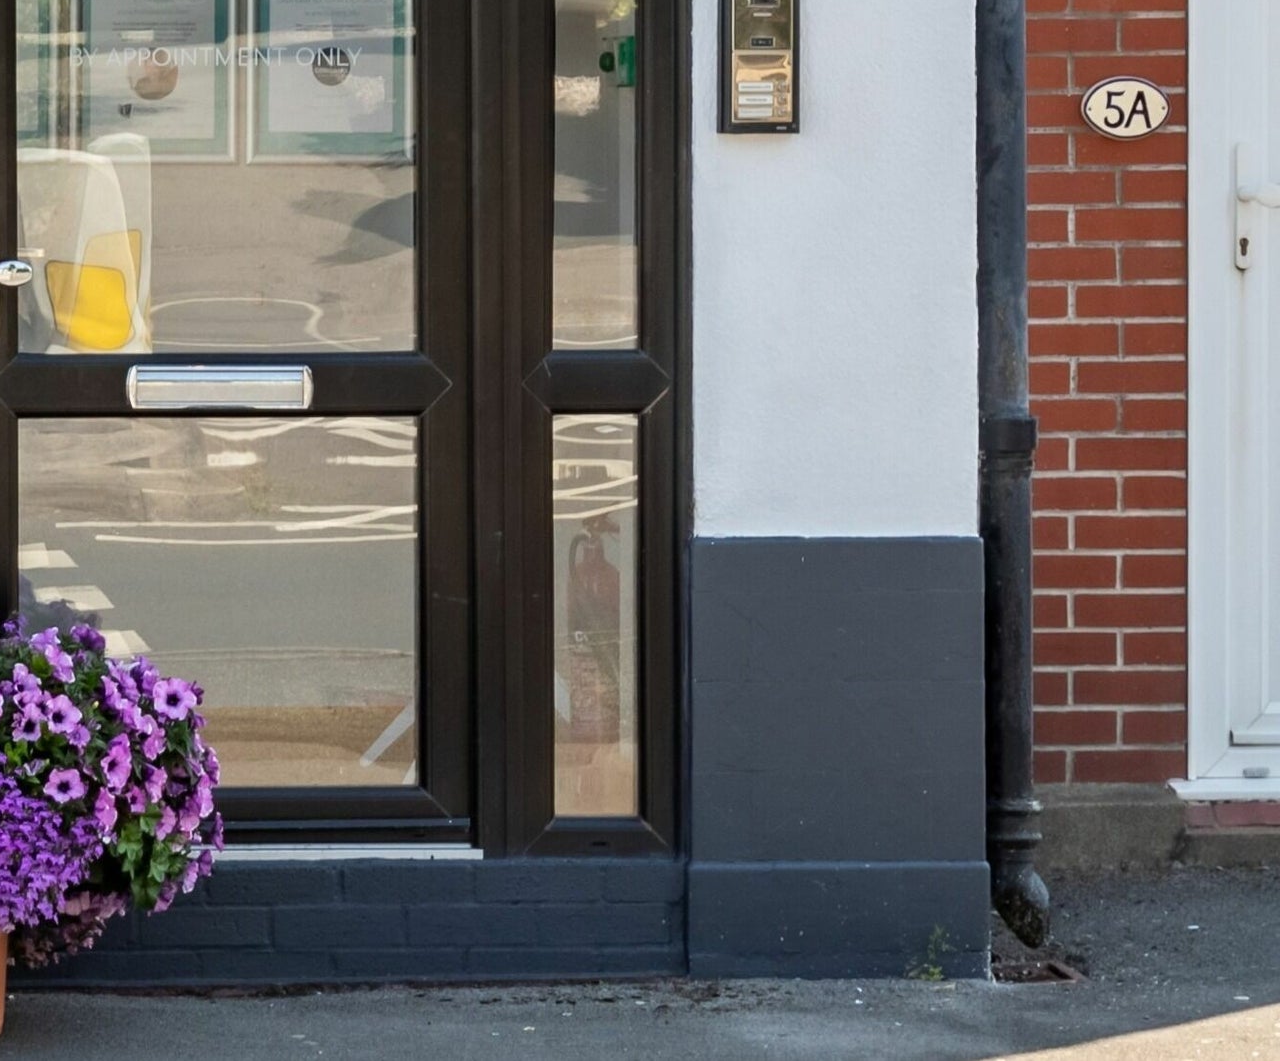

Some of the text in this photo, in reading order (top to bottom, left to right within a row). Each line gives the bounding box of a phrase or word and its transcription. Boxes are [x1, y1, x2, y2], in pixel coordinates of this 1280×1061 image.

[68, 46, 363, 67] BY APPOINTMENT ONLY
[1104, 90, 1152, 128] 5A
